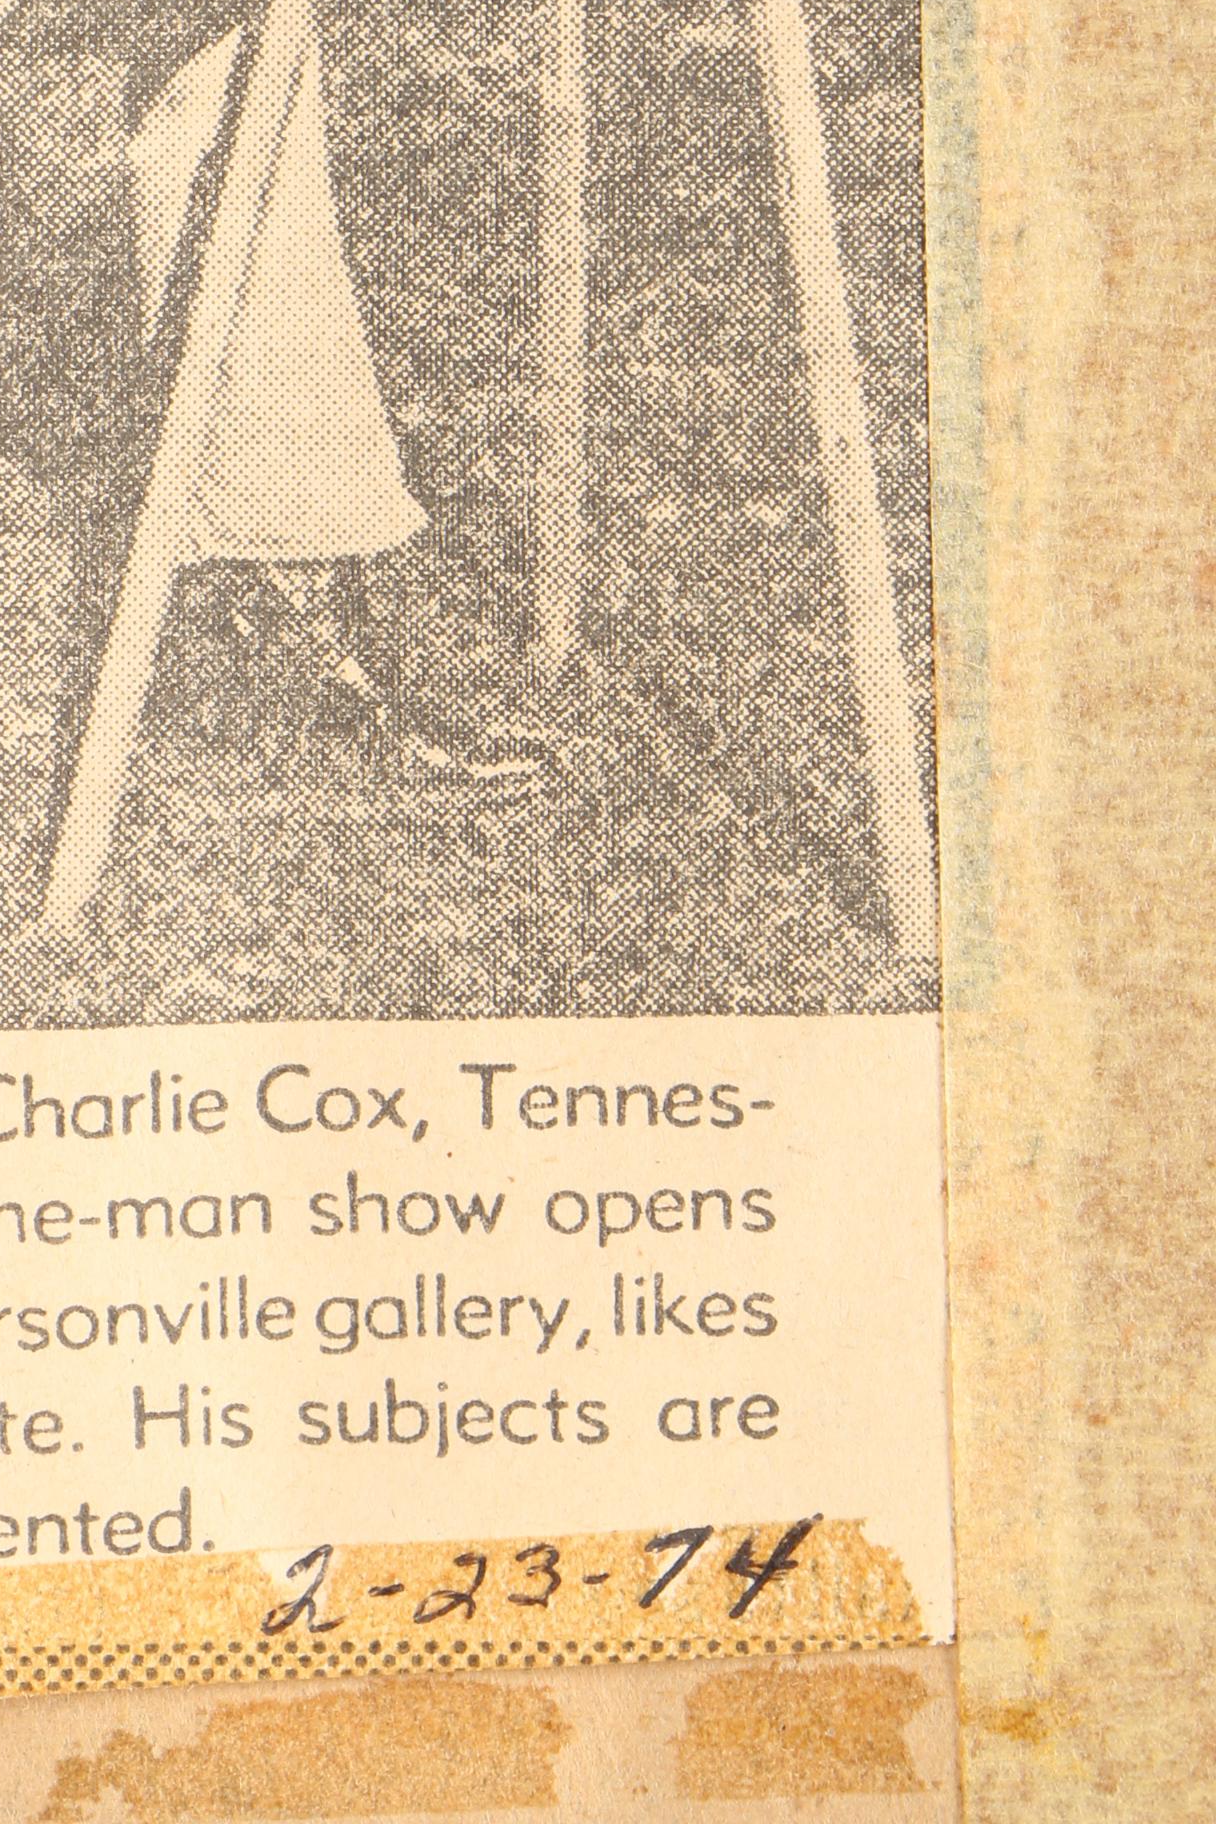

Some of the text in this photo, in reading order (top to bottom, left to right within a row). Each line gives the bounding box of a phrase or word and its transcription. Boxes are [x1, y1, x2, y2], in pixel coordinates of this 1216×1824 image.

[256, 1063, 429, 1143] Cox,
[459, 1063, 775, 1131] Tennes-
[309, 1170, 506, 1237] show
[545, 1188, 777, 1248] opens
[315, 1273, 591, 1355] gallery,
[613, 1272, 778, 1338] likes
[132, 1383, 253, 1450] His
[298, 1377, 610, 1458] subjects
[658, 1393, 780, 1442] are
[259, 1512, 825, 1636] 2-23-74
